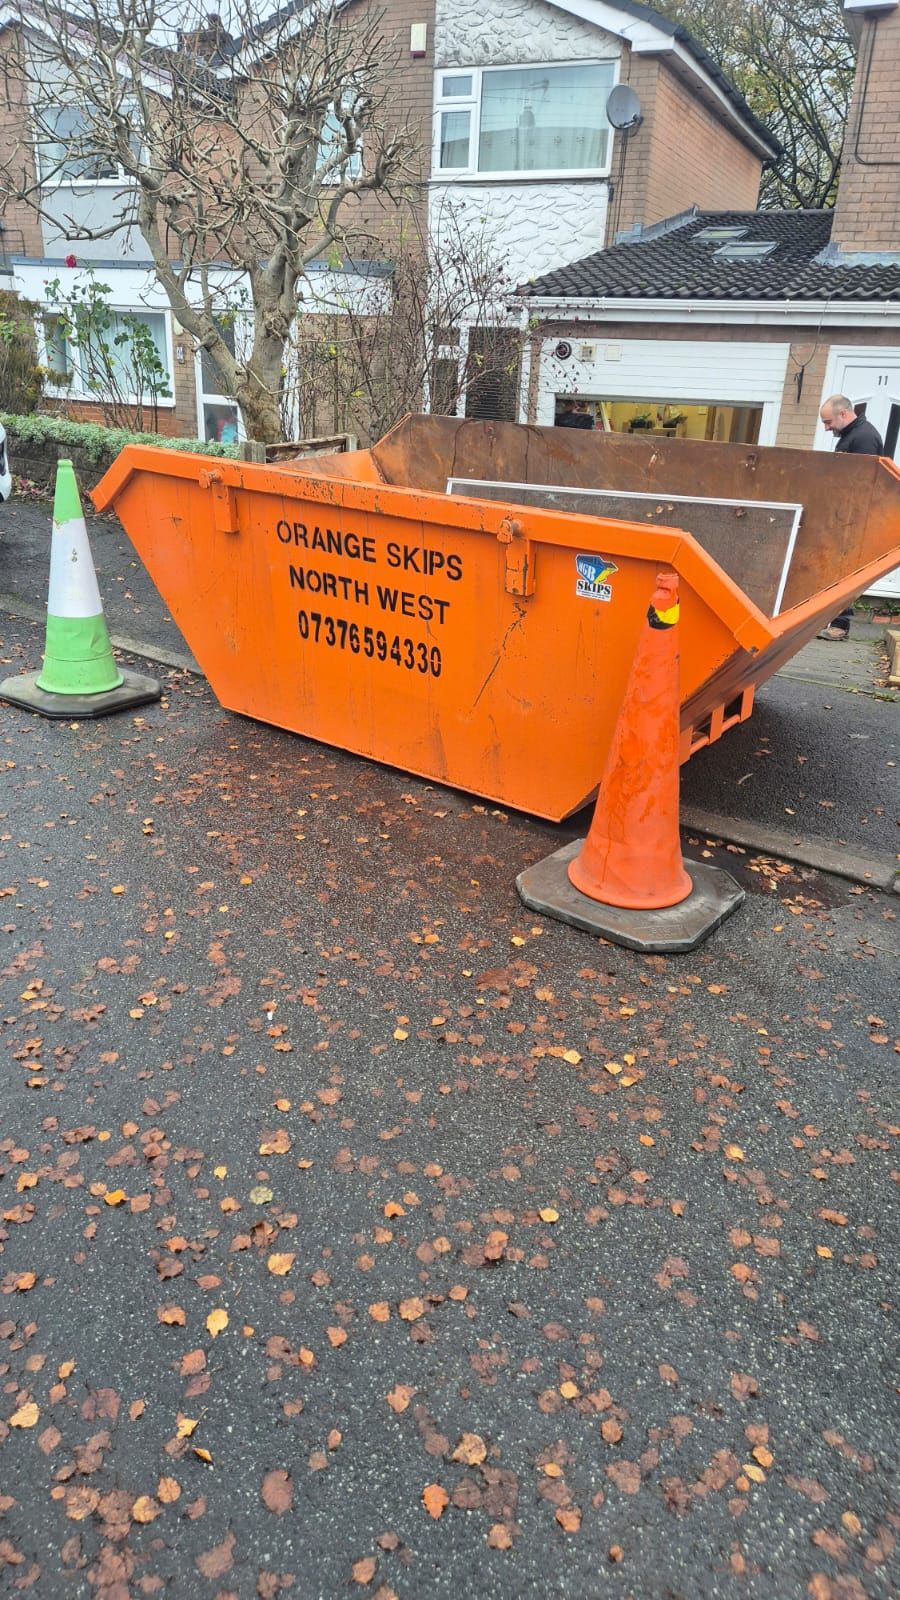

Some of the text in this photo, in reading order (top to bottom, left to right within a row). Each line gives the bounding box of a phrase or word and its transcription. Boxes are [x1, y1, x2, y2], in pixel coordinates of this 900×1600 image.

[878, 375, 888, 386] 11
[276, 520, 463, 581] ORANGE SKIPS
[289, 564, 450, 625] NORTH WEST
[577, 580, 611, 595] SKIPS
[298, 610, 442, 678] 07376594330
